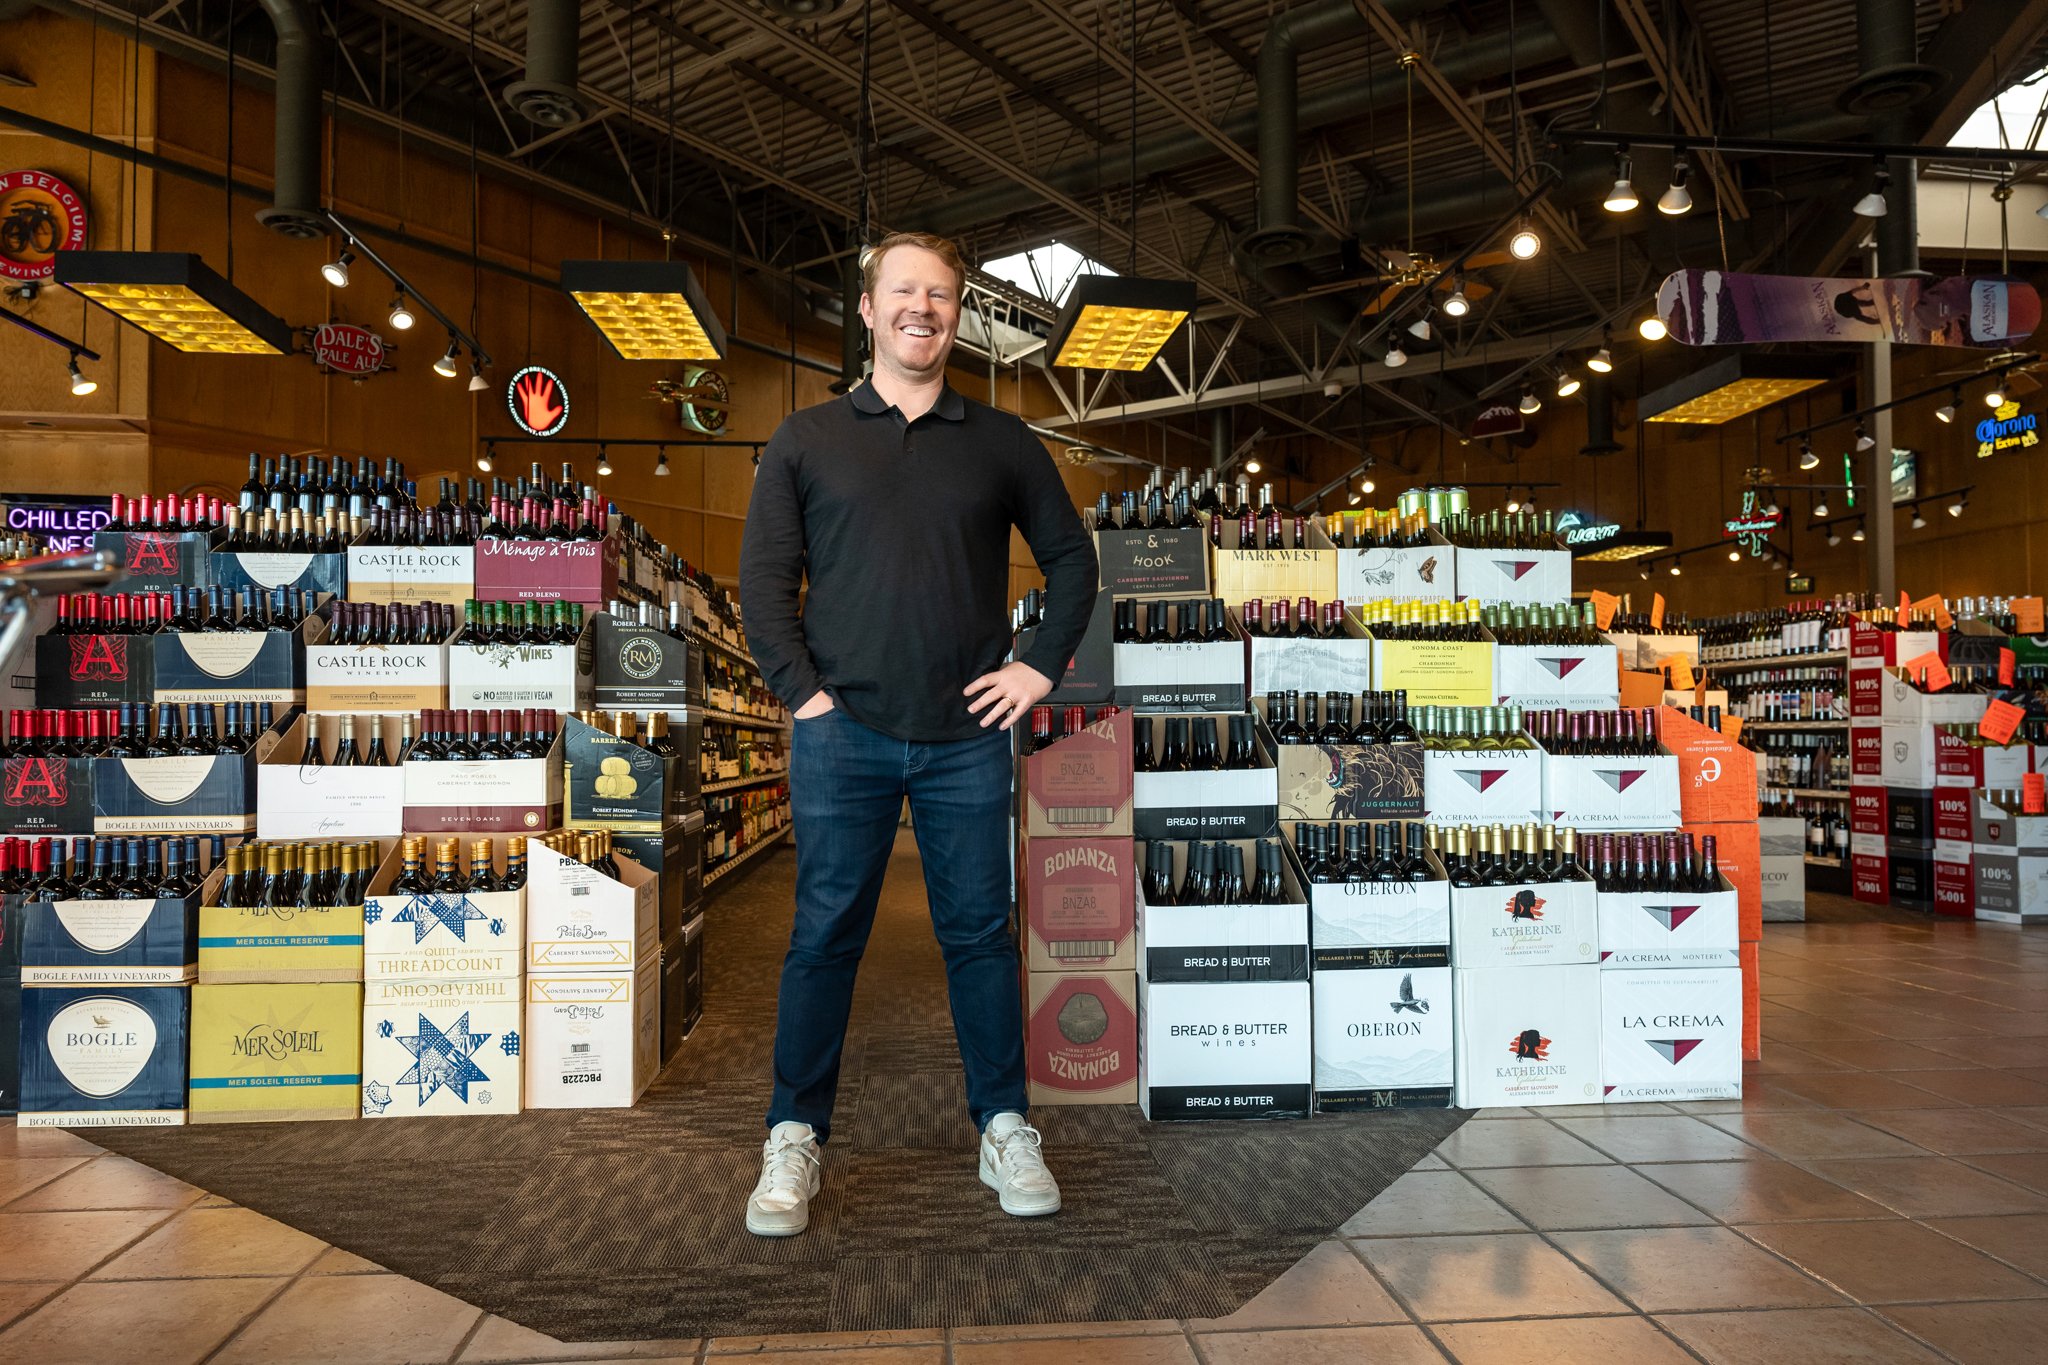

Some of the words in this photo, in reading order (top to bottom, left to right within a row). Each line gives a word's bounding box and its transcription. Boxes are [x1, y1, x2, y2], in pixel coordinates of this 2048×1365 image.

[22, 174, 84, 242] BELGIUM
[1811, 281, 1841, 335] ALASKAN
[1982, 284, 1997, 337] ALASKAN
[320, 325, 381, 355] DALE'S
[320, 348, 349, 364] PALE
[354, 355, 378, 370] ALE
[1976, 414, 2036, 443] Corona
[1995, 437, 2021, 450] Extra
[9, 508, 111, 531] CHILLED
[1147, 534, 1159, 548] &
[484, 541, 546, 561] Ménage
[561, 541, 596, 557] Trois
[1232, 550, 1275, 561] MARK
[358, 554, 413, 566] CASTLE
[419, 554, 461, 567] ROCK
[1133, 554, 1175, 568] HOOK
[75, 634, 123, 674] A
[516, 645, 552, 662] WINES
[630, 650, 653, 667] RM
[317, 656, 377, 668] CASTLE
[382, 656, 427, 668] ROCK
[1855, 679, 1879, 690] 100%
[483, 691, 496, 700] NO
[534, 691, 553, 700] VEGAN
[1142, 695, 1172, 703] BREAD
[1174, 694, 1180, 702] &
[1182, 693, 1216, 702] BUTTER
[1857, 738, 1880, 748] 100%
[1060, 763, 1096, 775] BNZA8
[9, 758, 62, 798] A
[1855, 796, 1879, 807] 100%
[1939, 800, 1966, 812] 100%
[140, 822, 176, 830] FAMILY
[179, 821, 233, 829] VINEYARDS
[1166, 817, 1198, 827] BREAD
[1201, 817, 1206, 826] &
[1209, 816, 1246, 826] BUTTER
[1044, 847, 1118, 878] BONANZA
[1981, 867, 2012, 881] 100%
[1344, 881, 1417, 896] OBERON
[1857, 881, 1881, 893] 100%
[1937, 890, 1965, 903] 100%
[1062, 897, 1097, 910] BNZA8
[1492, 925, 1562, 937] KATHERINE
[424, 947, 457, 957] QUILT
[1632, 954, 1671, 962] CREMA
[377, 957, 503, 973] THREADCOUNT
[1183, 957, 1219, 968] BREAD
[1222, 957, 1228, 967] &
[1231, 956, 1271, 967] BUTTER
[33, 972, 68, 981] BOGLE
[71, 972, 110, 981] FAMILY
[112, 971, 171, 981] VINEYARDS
[381, 982, 507, 998] THREADCOUNT
[427, 998, 461, 1008] QUILT
[1623, 1016, 1647, 1028] LA
[1653, 1015, 1724, 1028] CREMA
[1170, 1025, 1218, 1037] BREAD
[1222, 1025, 1230, 1036] &
[1234, 1023, 1288, 1036] BUTTER
[1347, 1021, 1422, 1037] OBERON
[66, 1032, 137, 1047] BOGLE
[271, 1030, 323, 1053] SOLEIL
[1201, 1038, 1257, 1047] wines
[1048, 1050, 1120, 1081] BONANZA
[1496, 1065, 1567, 1077] KATHERINE
[228, 1078, 247, 1087] MER
[249, 1077, 281, 1086] SOLEIL
[283, 1076, 323, 1085] RESERVE
[562, 1073, 602, 1084] PBC222B
[1637, 1088, 1676, 1096] CREMA
[1186, 1097, 1222, 1107] BREAD
[1225, 1096, 1230, 1106] &
[1233, 1095, 1274, 1106] BUTTER
[29, 1117, 66, 1126] BOGLE
[69, 1116, 107, 1126] FAMILY
[110, 1116, 171, 1125] VINEYARDS
